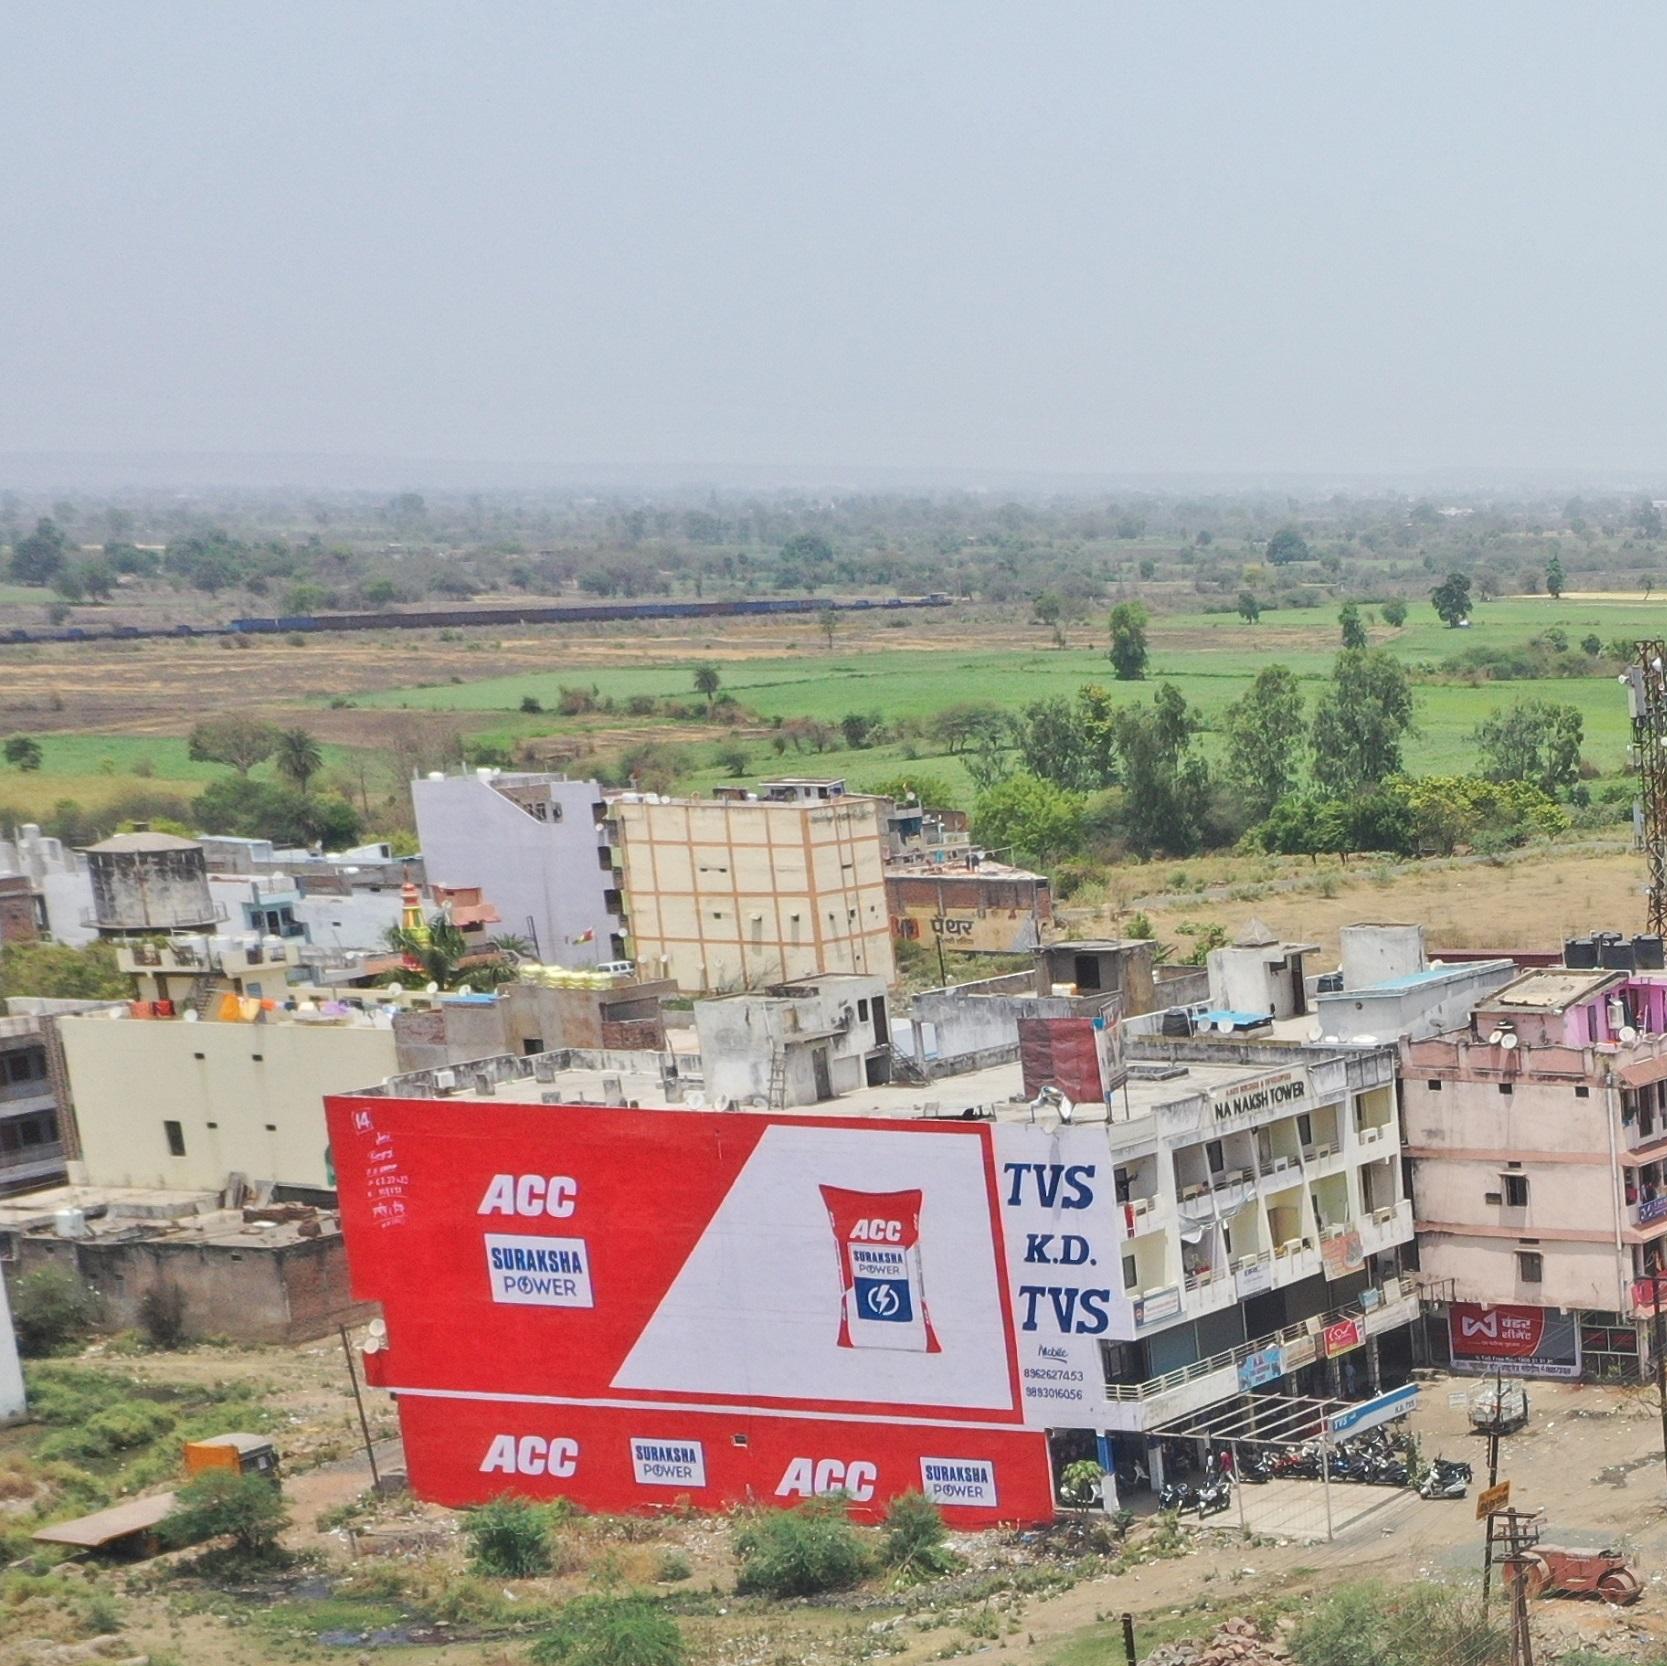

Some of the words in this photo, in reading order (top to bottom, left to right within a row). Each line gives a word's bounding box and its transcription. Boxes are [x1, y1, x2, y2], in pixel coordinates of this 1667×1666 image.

[1234, 1091, 1268, 1114] NAKSH
[1270, 1081, 1305, 1104] TOWER
[477, 1174, 577, 1218] ACC
[1003, 1162, 1096, 1210] TVS
[850, 1218, 902, 1242] ACC
[491, 1247, 583, 1275] SURAKSHA
[853, 1249, 903, 1264] SURAKSHA
[1023, 1233, 1097, 1266] K.D.
[859, 1264, 900, 1275] POWER
[503, 1275, 577, 1297] POWER
[1018, 1285, 1111, 1335] TVS
[1334, 1415, 1348, 1430] TVS
[479, 1434, 579, 1478] ACC
[635, 1445, 697, 1464] SURAKSHA
[643, 1464, 692, 1478] POWER
[774, 1457, 877, 1502] ACC
[925, 1464, 989, 1483] SURAKSHA
[933, 1483, 984, 1498] POWER
